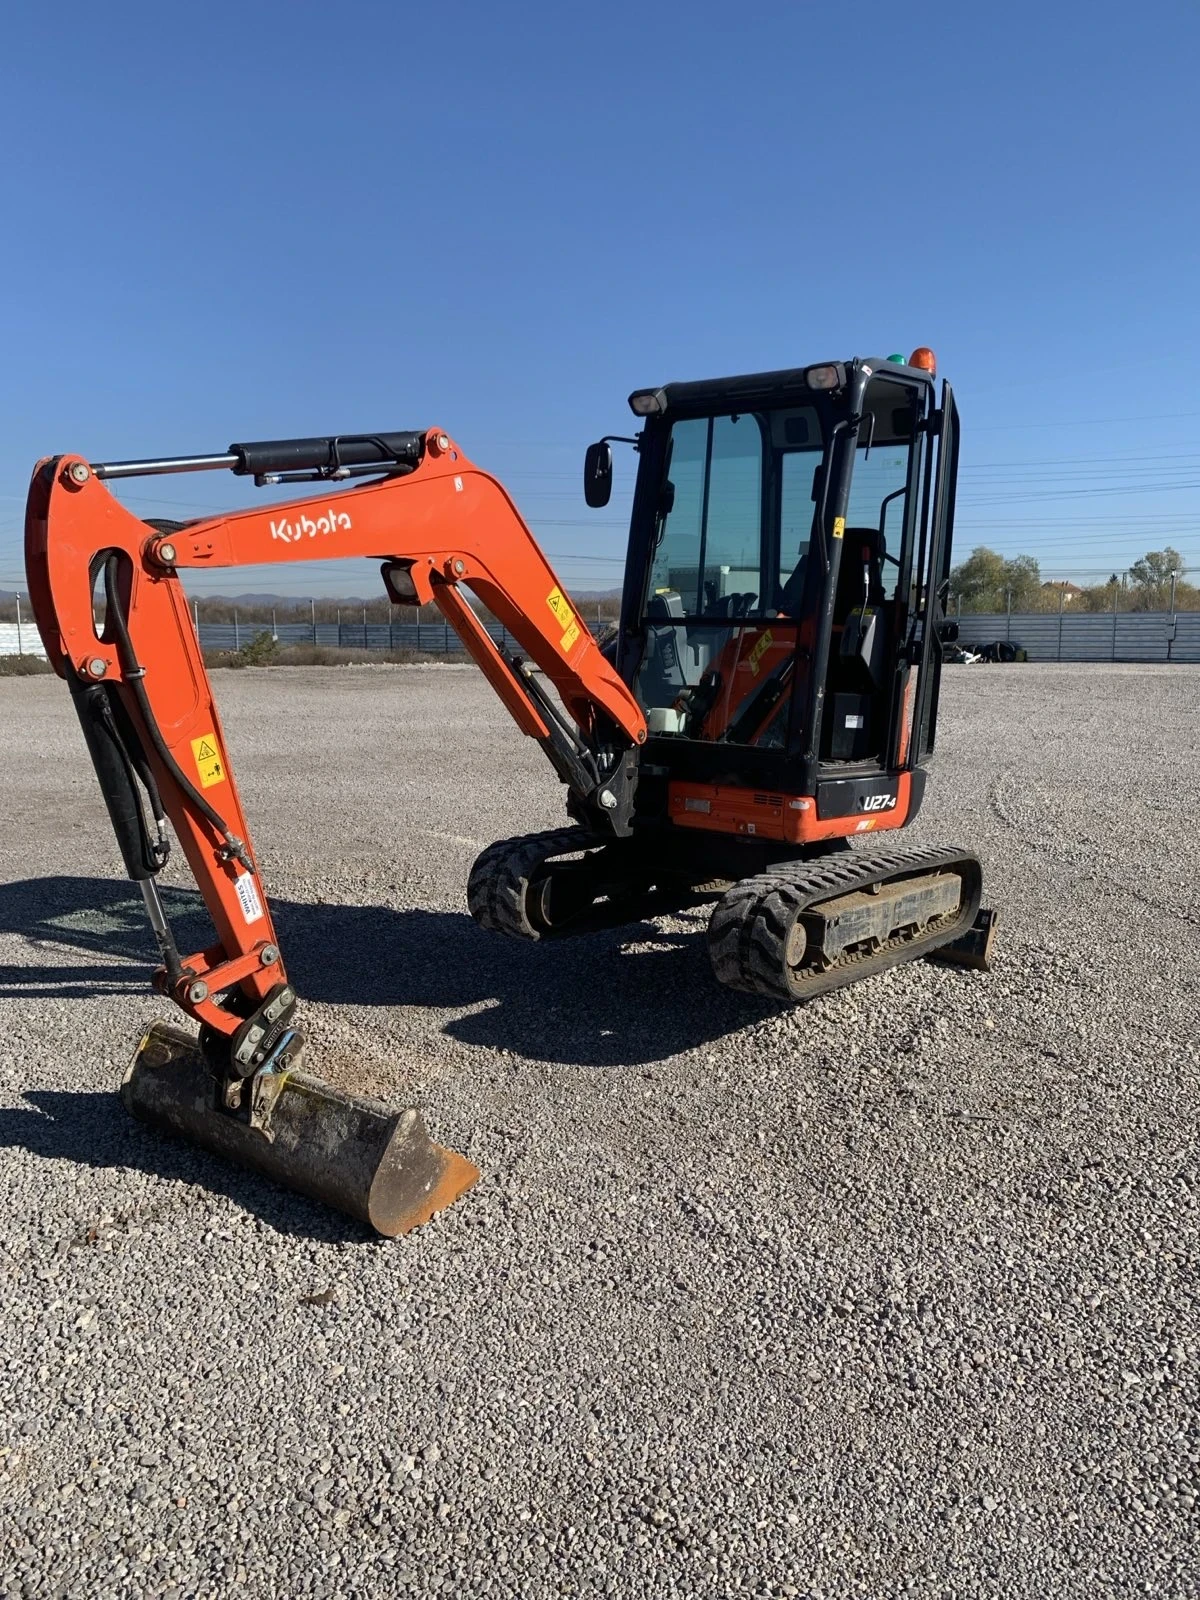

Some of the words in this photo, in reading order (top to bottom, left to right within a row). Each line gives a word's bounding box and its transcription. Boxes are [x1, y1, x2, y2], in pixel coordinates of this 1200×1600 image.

[270, 509, 352, 543] Kubota
[864, 794, 897, 811] U27-4
[238, 884, 251, 915] WHITES
